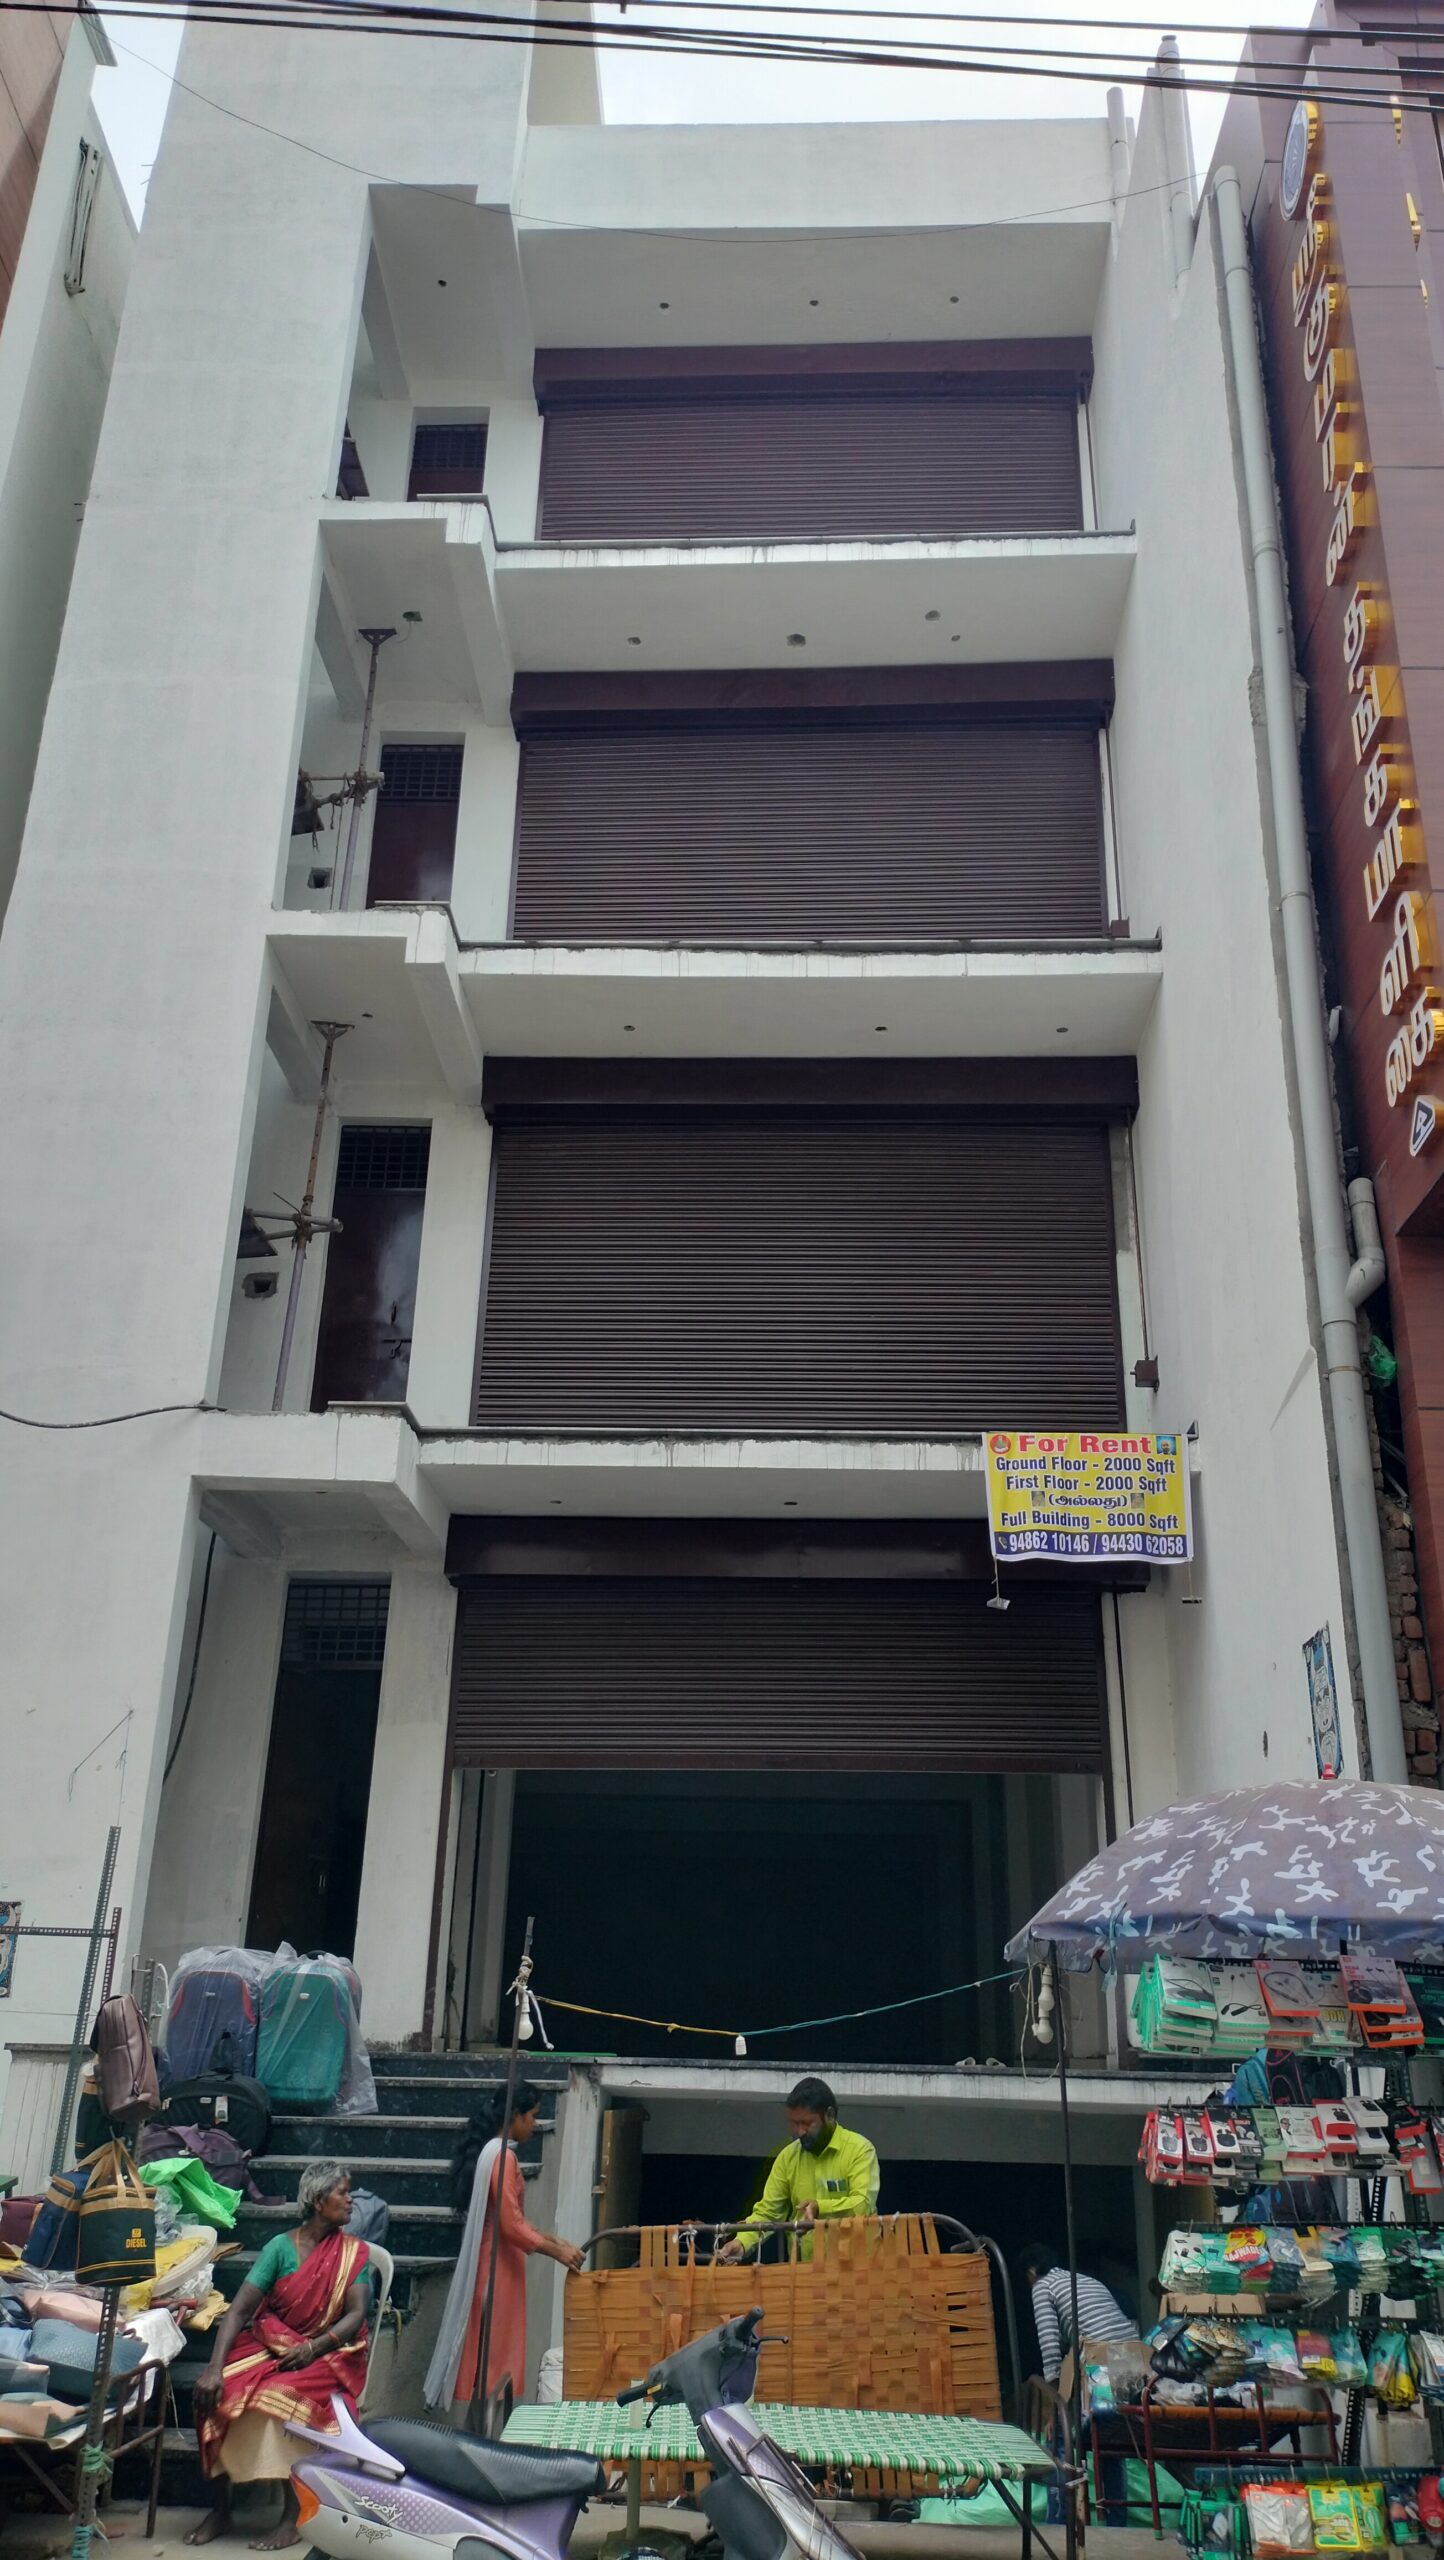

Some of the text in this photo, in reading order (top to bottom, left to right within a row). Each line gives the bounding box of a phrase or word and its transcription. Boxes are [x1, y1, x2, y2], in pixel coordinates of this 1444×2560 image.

[1019, 1434, 1152, 1454] For Rent
[996, 1456, 1046, 1471] Ground
[1052, 1456, 1088, 1471] Floor
[1104, 1457, 1142, 1471] 2000
[1147, 1458, 1175, 1475] Sqft
[1006, 1475, 1039, 1490] First
[1044, 1475, 1079, 1490] Floor
[1095, 1476, 1133, 1490] 2000
[1139, 1476, 1167, 1495] Sqft
[1048, 1493, 1127, 1509] (அல்லது)
[1001, 1511, 1026, 1526] Full
[1032, 1510, 1090, 1530] Building
[1107, 1512, 1145, 1526] 8000
[1149, 1514, 1178, 1532] Sqft
[1009, 1530, 1048, 1552] 94862
[1052, 1532, 1089, 1553] 10146
[1101, 1533, 1143, 1552] 94430
[1145, 1534, 1183, 1555] 62058
[125, 2238, 147, 2248] DIESEL
[354, 2496, 403, 2524] Scooty
